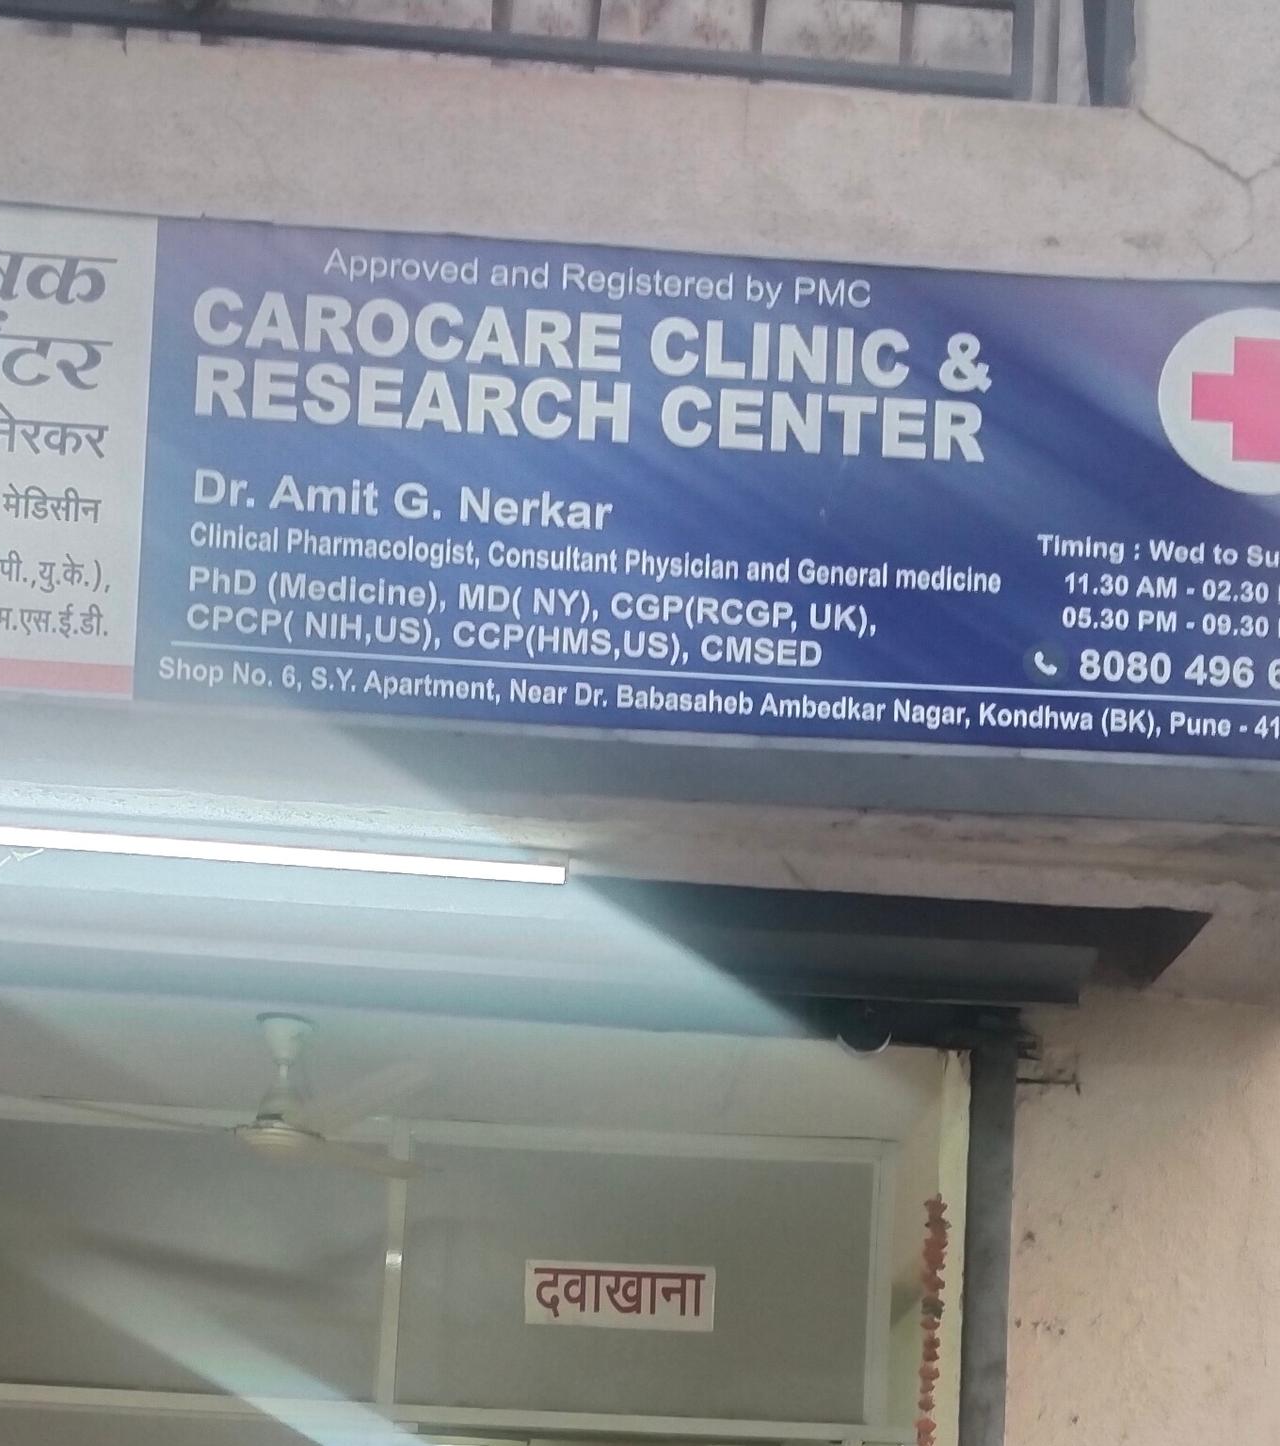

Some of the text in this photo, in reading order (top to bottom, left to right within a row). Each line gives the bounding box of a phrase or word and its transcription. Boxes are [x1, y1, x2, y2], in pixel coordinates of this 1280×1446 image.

[323, 248, 873, 309] Approved and Registered by PMC
[193, 287, 992, 394] CAROCARE CLINIC &
[193, 356, 984, 463] RESEARCH CENTER
[194, 469, 613, 530] Dr. Amit G. Nerkar
[190, 521, 1002, 594] Clinical Pharmacologist, Consultant Physician and General medicine
[1037, 533, 1124, 565] Timing
[1149, 539, 1205, 565] Wed
[1213, 542, 1239, 567] to
[1064, 572, 1129, 597] 11.30
[1135, 575, 1177, 599] AM
[1202, 578, 1269, 605] 02.30
[1062, 606, 1129, 630] 05.30
[1138, 609, 1177, 633] PM
[1202, 613, 1269, 638] 09.30
[158, 656, 224, 687] Shop
[232, 661, 273, 688] No.
[281, 665, 302, 692] 6,
[311, 667, 357, 693] S.Y.
[364, 671, 502, 706] Apartment,
[509, 679, 567, 705] Near
[574, 682, 608, 708] Dr.
[616, 683, 754, 715] Babasaheb
[760, 692, 887, 723] Ambedkar
[893, 698, 970, 729] Nagar,
[979, 703, 1093, 731] Kondhwa
[1101, 707, 1161, 740] (BK),
[1170, 712, 1231, 738] Pune
[1079, 649, 1172, 685] 8080
[1184, 654, 1255, 688] 496
[534, 1268, 706, 1317] दवाखाना
